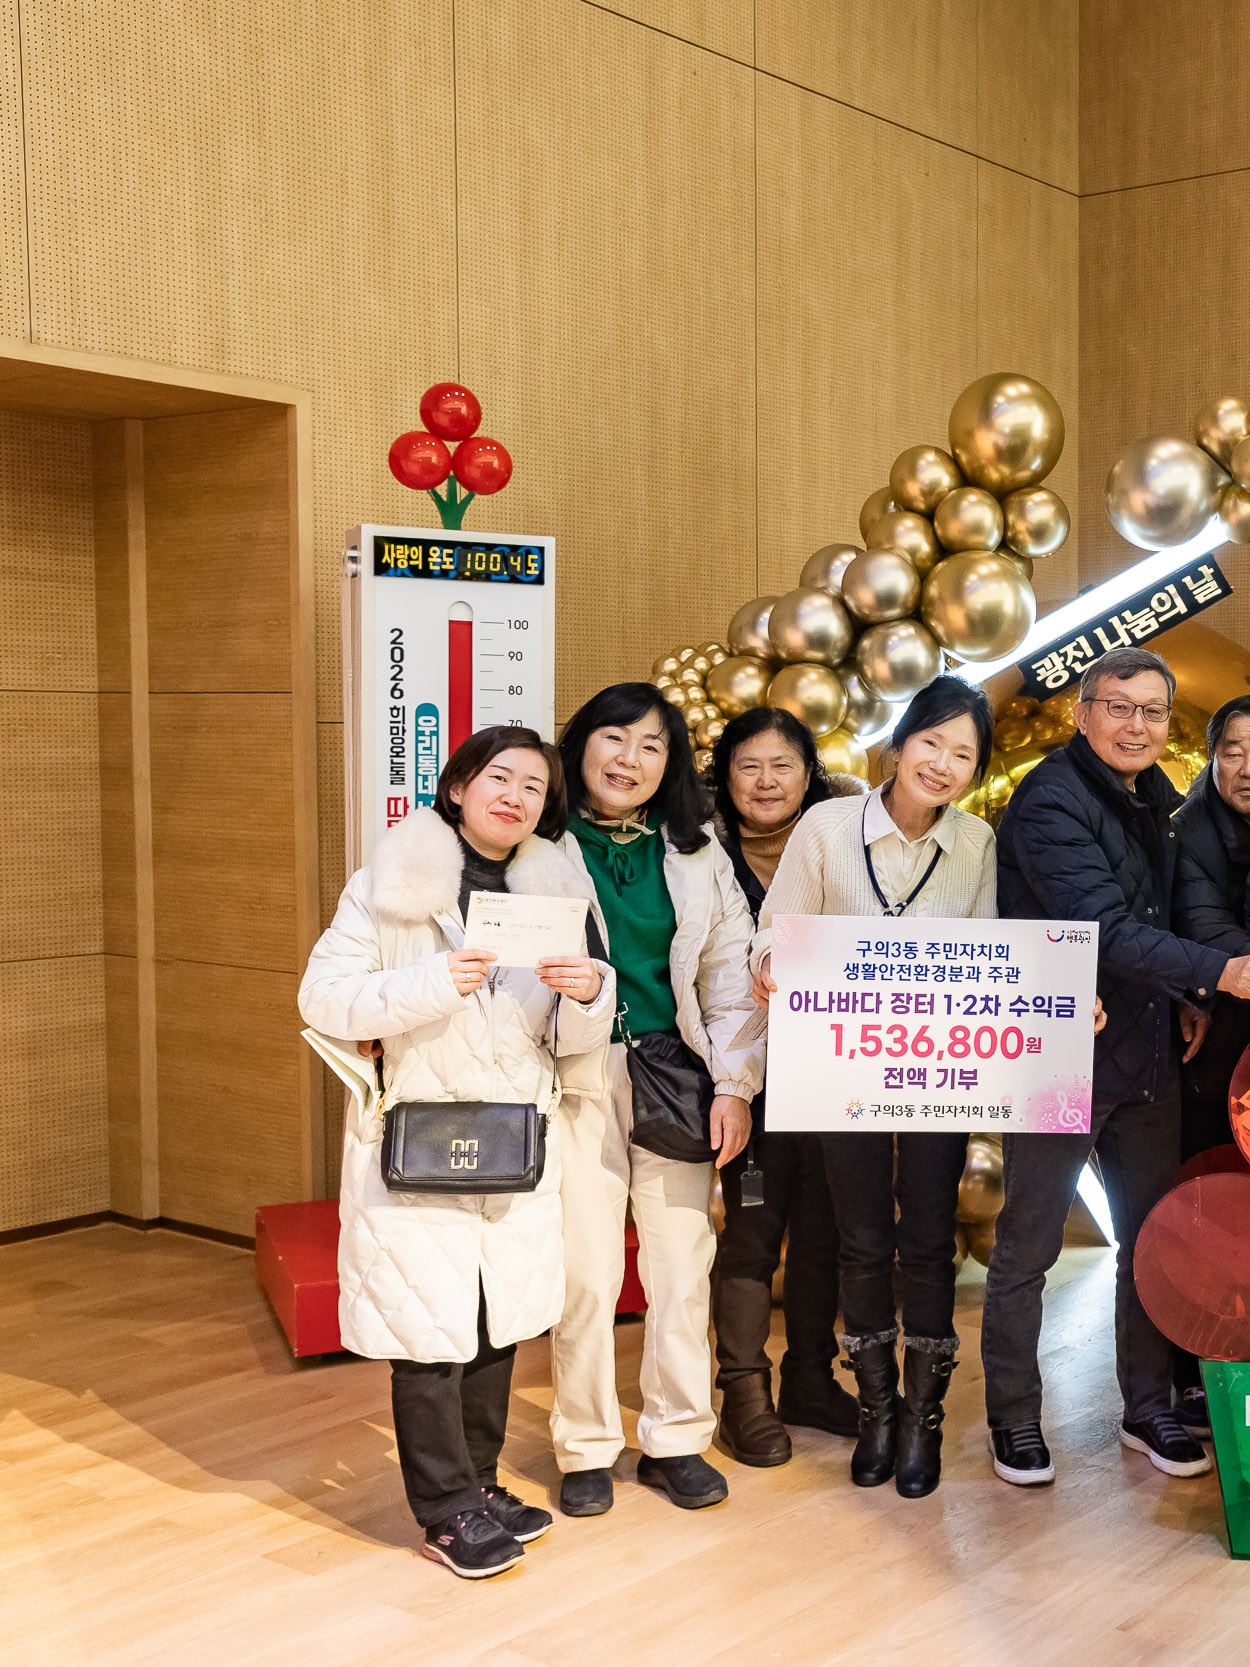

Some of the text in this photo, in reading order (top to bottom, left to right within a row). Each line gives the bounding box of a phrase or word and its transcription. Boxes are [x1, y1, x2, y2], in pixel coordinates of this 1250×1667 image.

[382, 543, 423, 570] 사랑의
[427, 546, 455, 570] 온도
[507, 619, 529, 631] 100
[1031, 564, 1223, 689] 광진 나눔의 날
[507, 650, 523, 662] 90
[507, 684, 523, 696] 80
[389, 627, 407, 786] 2026 희망온돌
[507, 719, 523, 729] 70
[417, 715, 438, 795] 우리동네
[855, 940, 1011, 962] 구의3동 주민자치회
[843, 962, 1022, 984] 생활안전환경분과 주관
[789, 990, 1077, 1019] 아나바다 장터 1·2차 수익금
[830, 1023, 1043, 1061] 1,536,800원
[883, 1067, 979, 1091] 전액 기부
[869, 1104, 1014, 1120] 구의3동 주민자치회 일동
